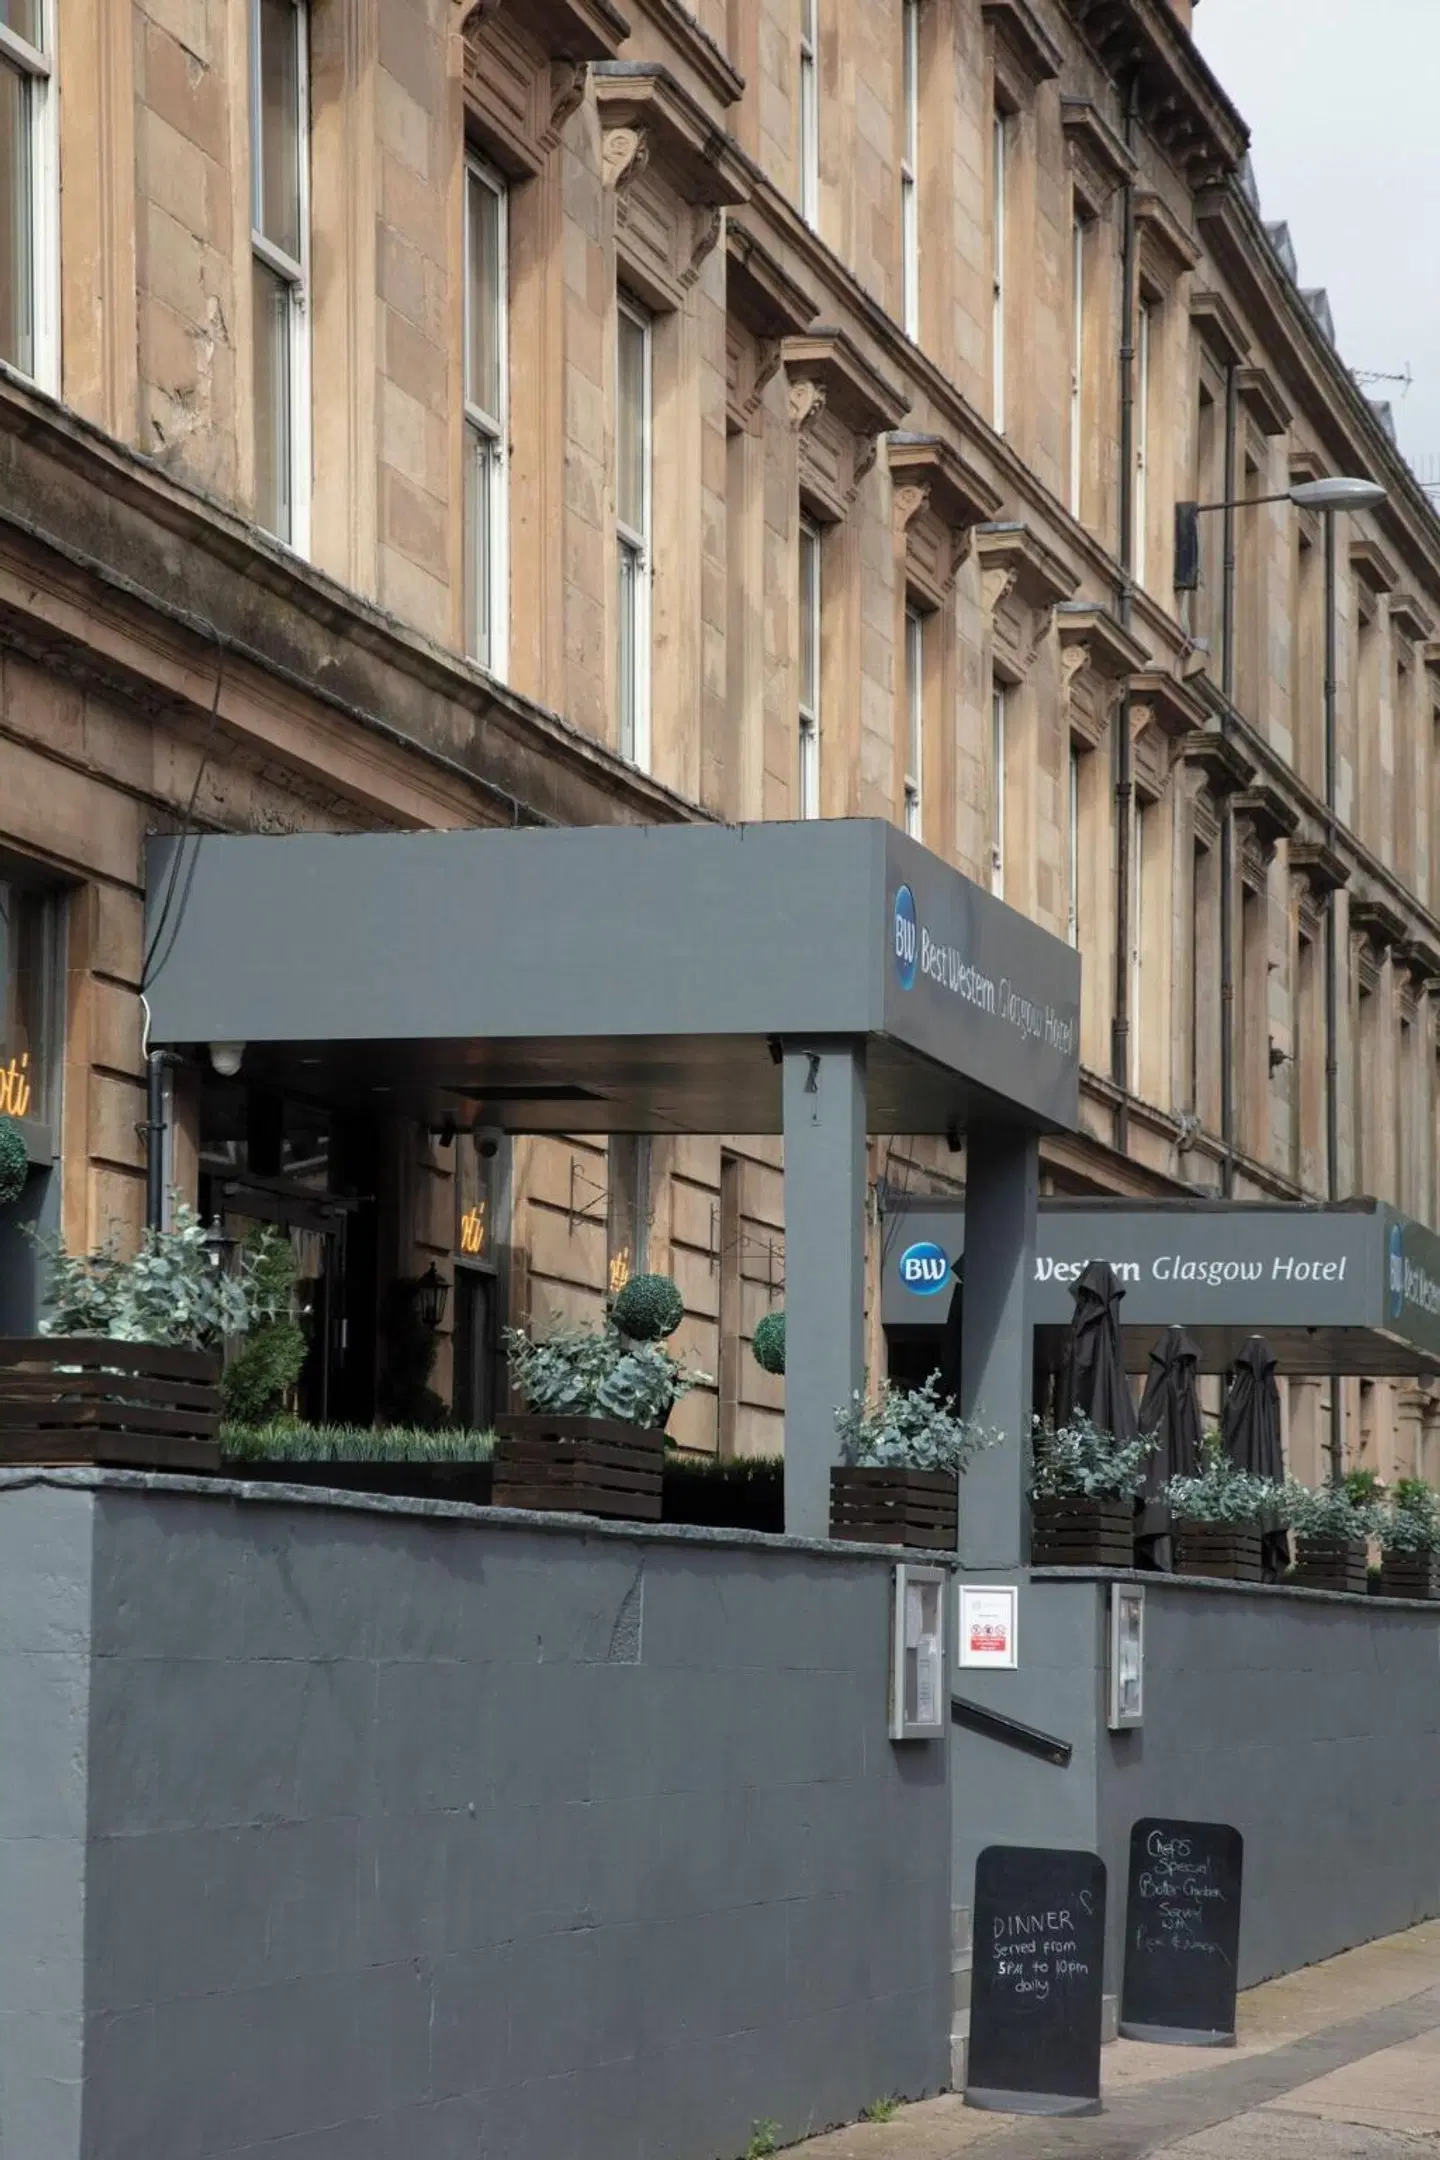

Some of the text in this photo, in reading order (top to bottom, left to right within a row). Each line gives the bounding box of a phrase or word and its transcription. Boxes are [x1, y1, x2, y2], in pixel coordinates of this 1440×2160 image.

[895, 914, 916, 963] BW
[921, 927, 1074, 1057] Best Western Glasgow Hotel
[904, 1259, 947, 1281] BW
[1151, 1255, 1263, 1286] Glasgow
[1271, 1255, 1347, 1281] Hotel
[993, 1909, 1075, 1938] DINNER
[1032, 1961, 1049, 1973] to
[1055, 1959, 1089, 1979] 10pm
[1014, 1978, 1050, 1999] daily
